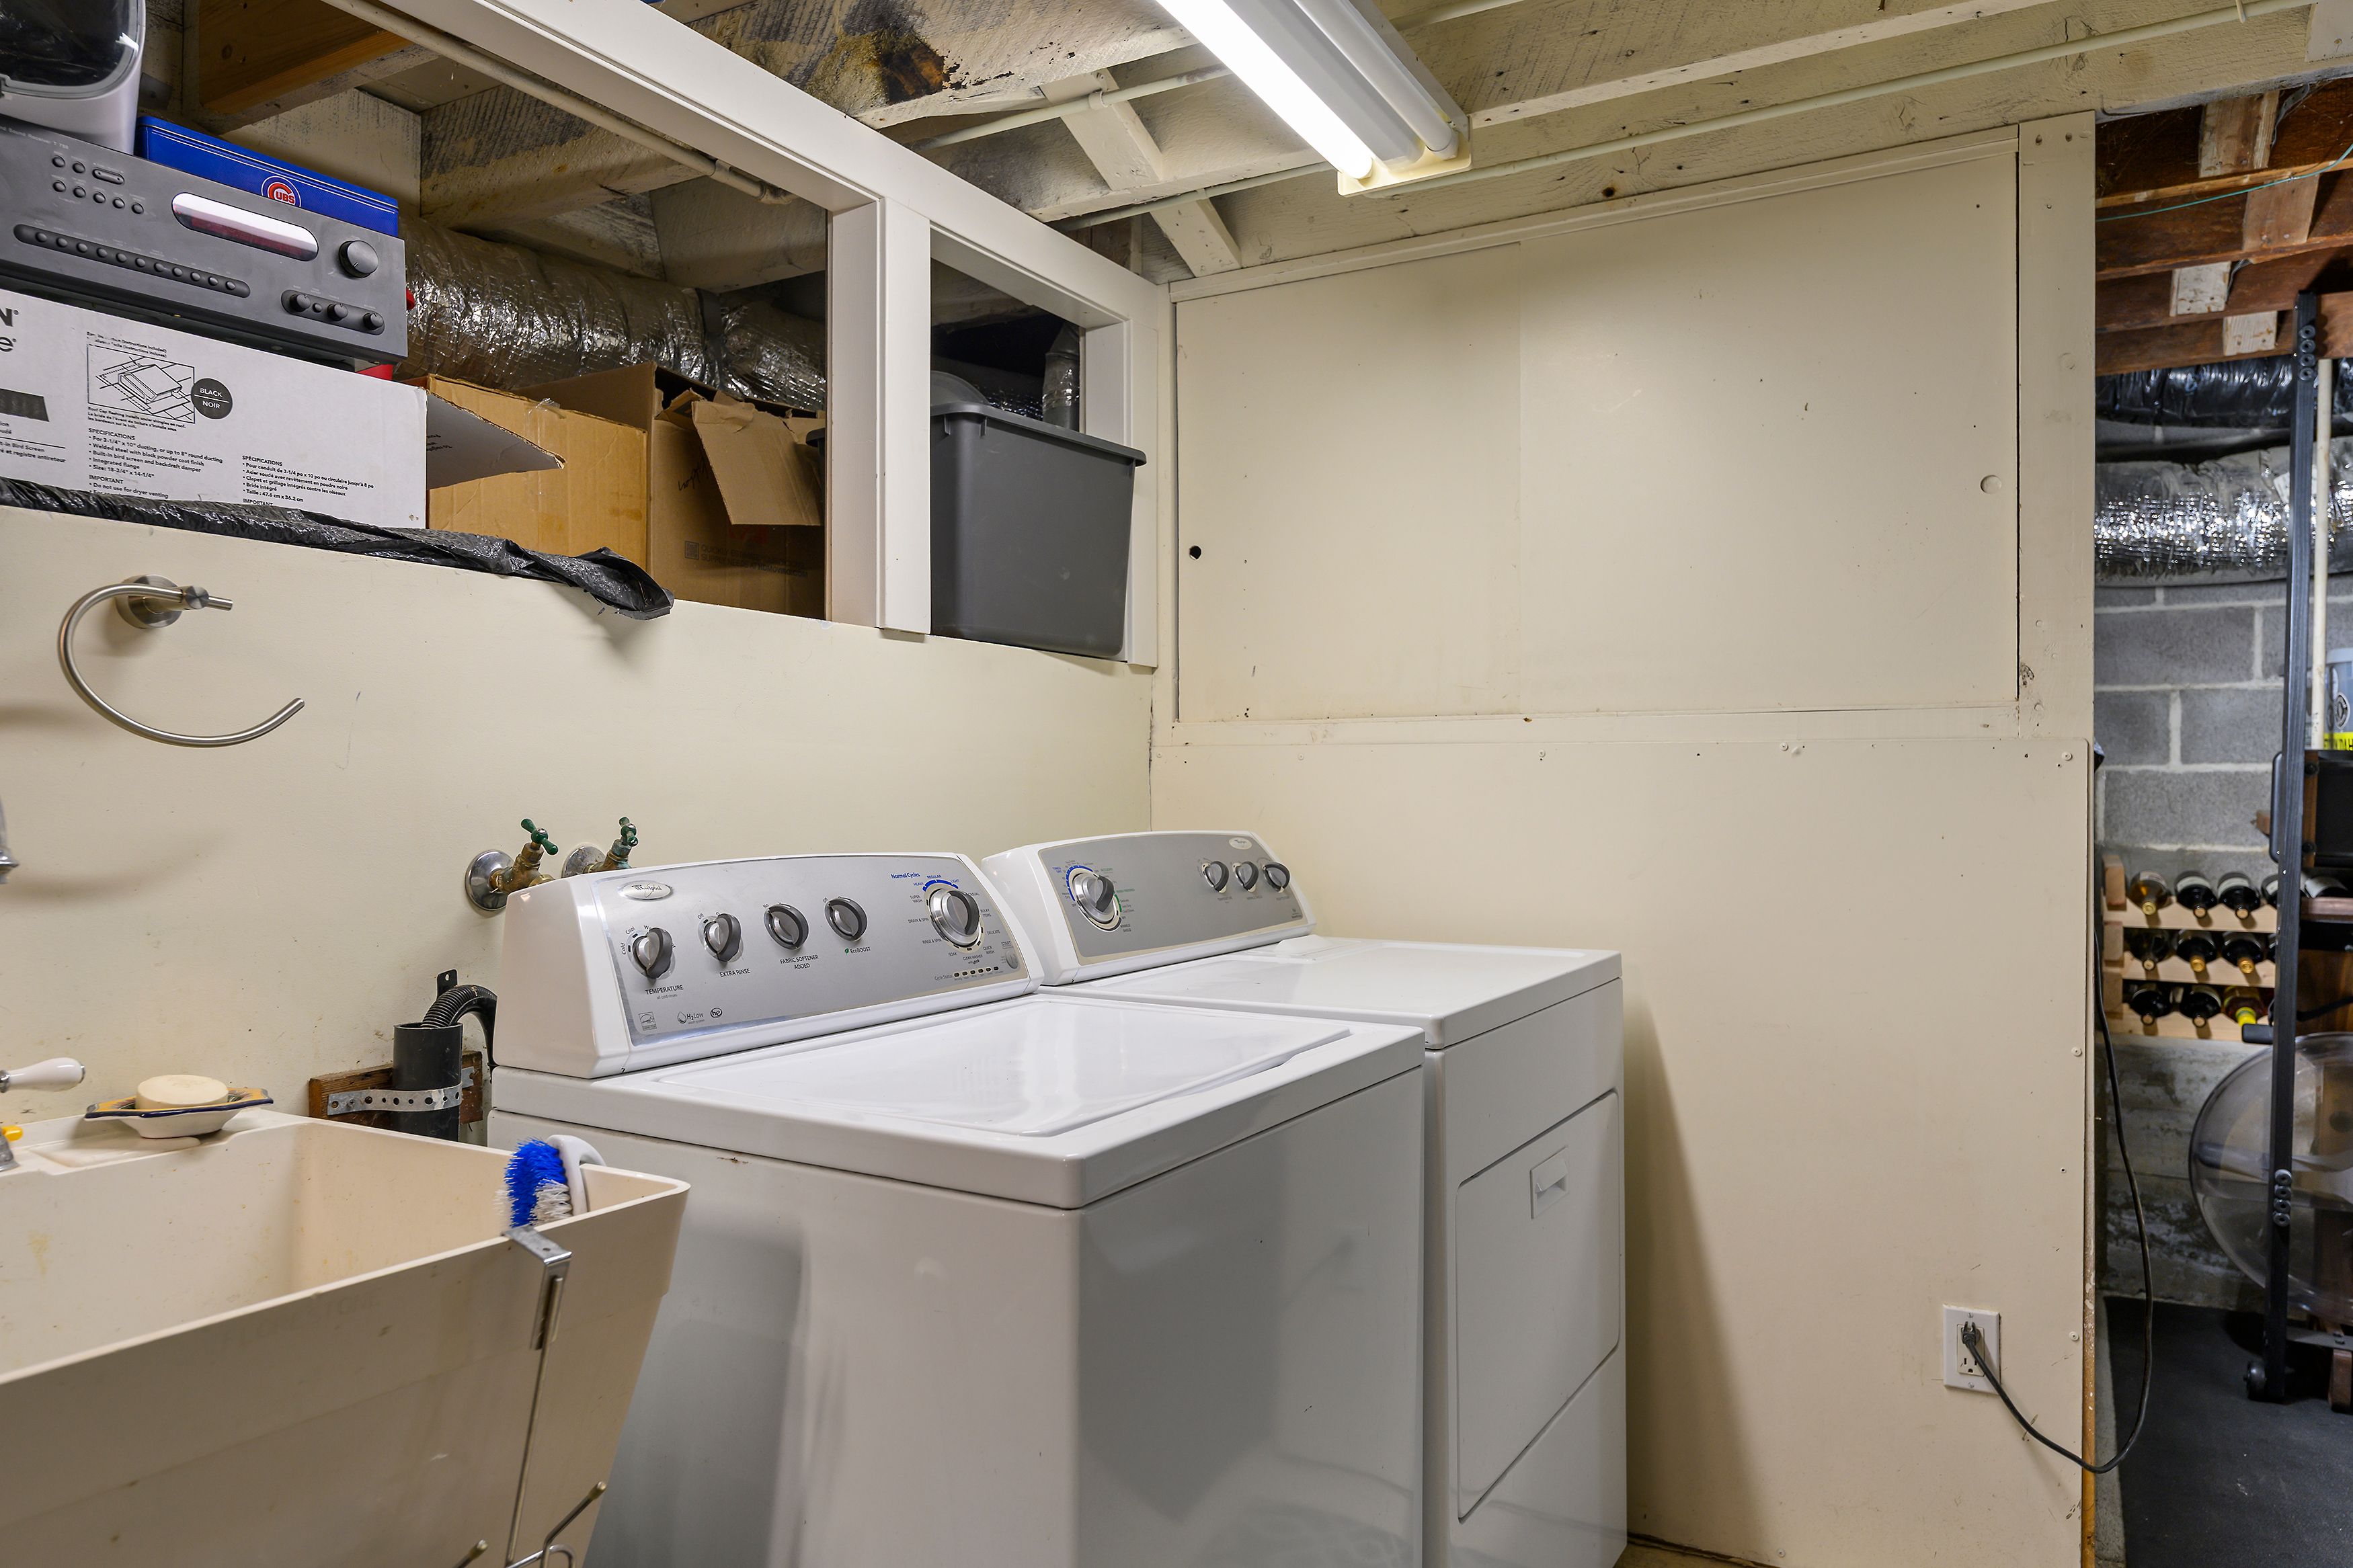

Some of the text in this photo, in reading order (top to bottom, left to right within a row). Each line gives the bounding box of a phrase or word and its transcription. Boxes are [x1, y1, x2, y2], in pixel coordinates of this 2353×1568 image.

[269, 183, 294, 204] CUBS
[200, 388, 222, 397] BLACK
[203, 401, 220, 409] NOIR
[89, 428, 134, 440] SPECIFICATIONS
[93, 443, 114, 452] Welded
[93, 450, 112, 458] Built-in
[155, 460, 180, 469] backdraft
[93, 458, 122, 466] Integrated
[204, 456, 223, 464] ducting
[243, 455, 282, 466] SPÉCIFICATIONS
[89, 474, 123, 484] IMPORTANT
[286, 476, 312, 485] revêtement
[133, 488, 147, 496] dryer
[260, 484, 277, 492] intégré
[625, 926, 635, 935] Cool
[645, 985, 684, 995] TEMPERATURE
